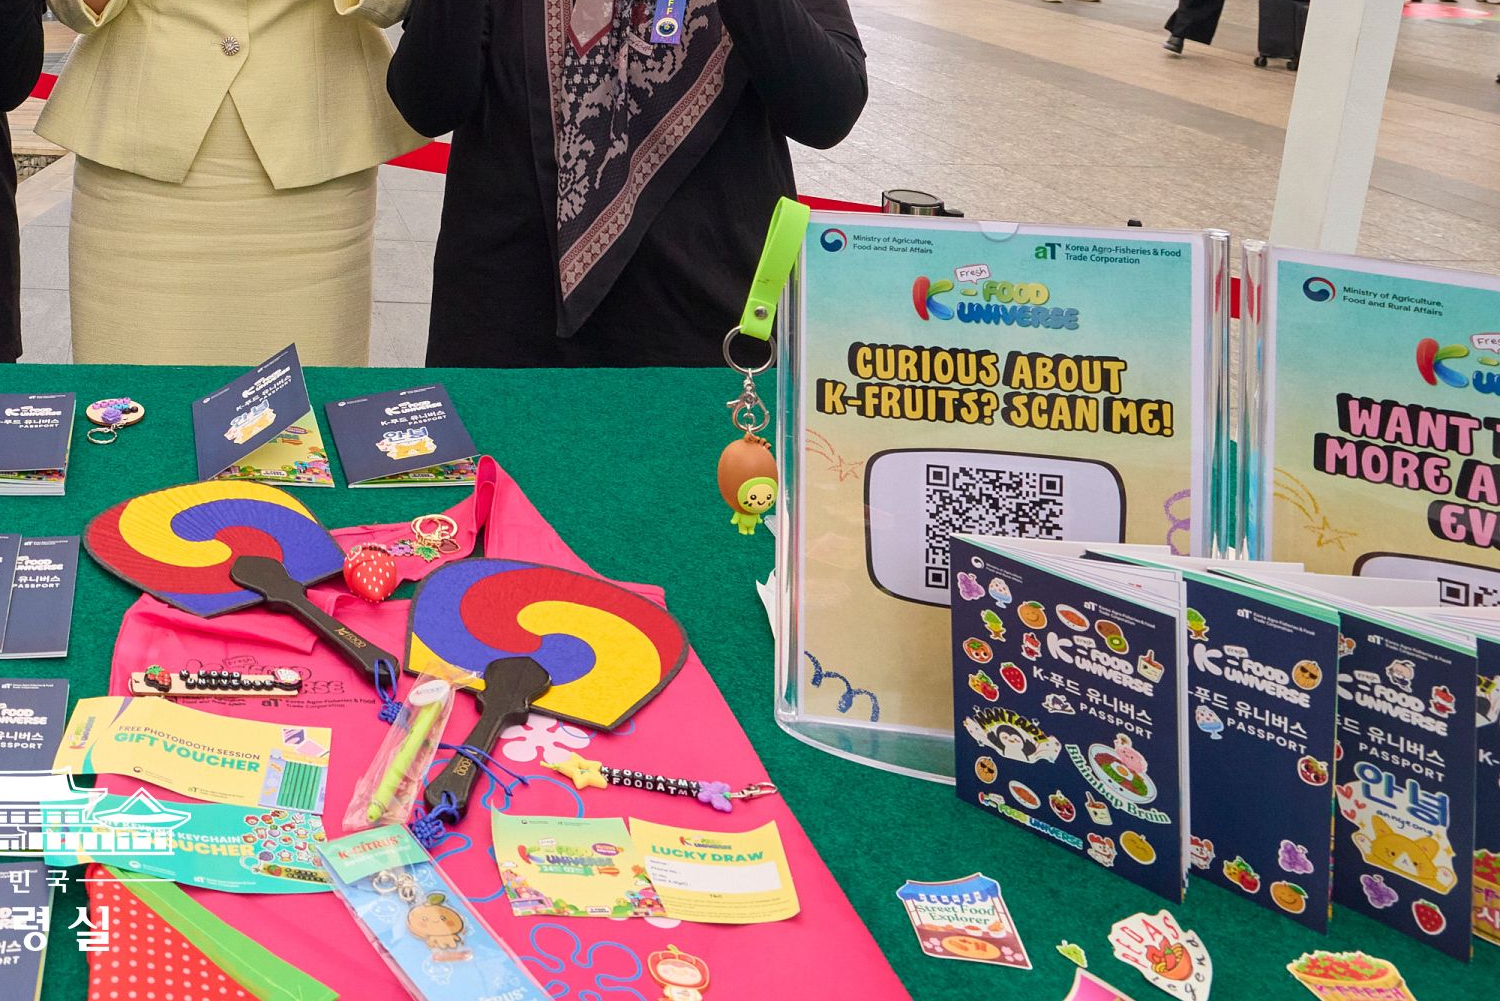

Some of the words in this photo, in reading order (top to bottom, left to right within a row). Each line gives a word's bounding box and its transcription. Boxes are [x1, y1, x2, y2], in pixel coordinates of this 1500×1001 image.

[853, 234, 882, 245] Ministry
[892, 236, 934, 247] Agriculture,
[909, 246, 933, 254] Affairs
[1065, 244, 1090, 254] Korea
[1091, 246, 1151, 257] Agro-Fisheries
[1160, 248, 1182, 258] Food
[959, 267, 987, 280] Fresh
[1065, 253, 1088, 263] Trade
[1090, 254, 1140, 266] Corporation
[956, 301, 1080, 330] UNIVERSE
[1342, 295, 1366, 305] Food
[1368, 299, 1386, 308] and
[1388, 302, 1411, 312] Rural
[1413, 306, 1443, 317] Affairs
[1343, 286, 1378, 298] Ministry
[1391, 293, 1444, 308] Agriculture,
[853, 344, 999, 386] CURIOUS
[1010, 354, 1127, 394] ABOUT
[408, 414, 446, 426] PASSPORT
[823, 381, 999, 425] K-FRUITS?
[1009, 394, 1099, 432] SCAN
[1111, 399, 1174, 437] ME!
[1347, 399, 1482, 455] WANT
[1325, 438, 1452, 495] MORE
[187, 678, 274, 687] UNIVERSE
[199, 670, 241, 679] FOOD
[1074, 655, 1155, 697] UNIVERSE
[1223, 666, 1311, 708] UNIVERSE
[1032, 666, 1081, 696] K-푸드
[1086, 687, 1153, 726] 유니버스
[1188, 686, 1230, 710] -푸드
[1234, 701, 1308, 740] 유니버스
[1355, 691, 1449, 736] UNIVERSE
[1079, 702, 1152, 739] PASSPORT
[1226, 717, 1308, 755] PASSPORT
[114, 732, 160, 748] GIFT
[160, 740, 260, 772] VOUCHER
[143, 726, 214, 753] PHOTOBOOTH
[216, 748, 260, 760] SESSION
[1367, 726, 1446, 768] 유니버스
[1359, 742, 1445, 782] PASSPORT
[1066, 744, 1124, 810] Bibimbap
[1126, 802, 1169, 824] Brain
[1355, 762, 1449, 828] 안녕
[177, 832, 240, 844] KEYCHAIN
[651, 844, 707, 860] LUCKY
[710, 850, 764, 862] DRAW
[916, 904, 958, 914] Street
[960, 904, 996, 916] Food
[929, 912, 990, 925] Explorer
[1115, 916, 1180, 968] PEDAS
